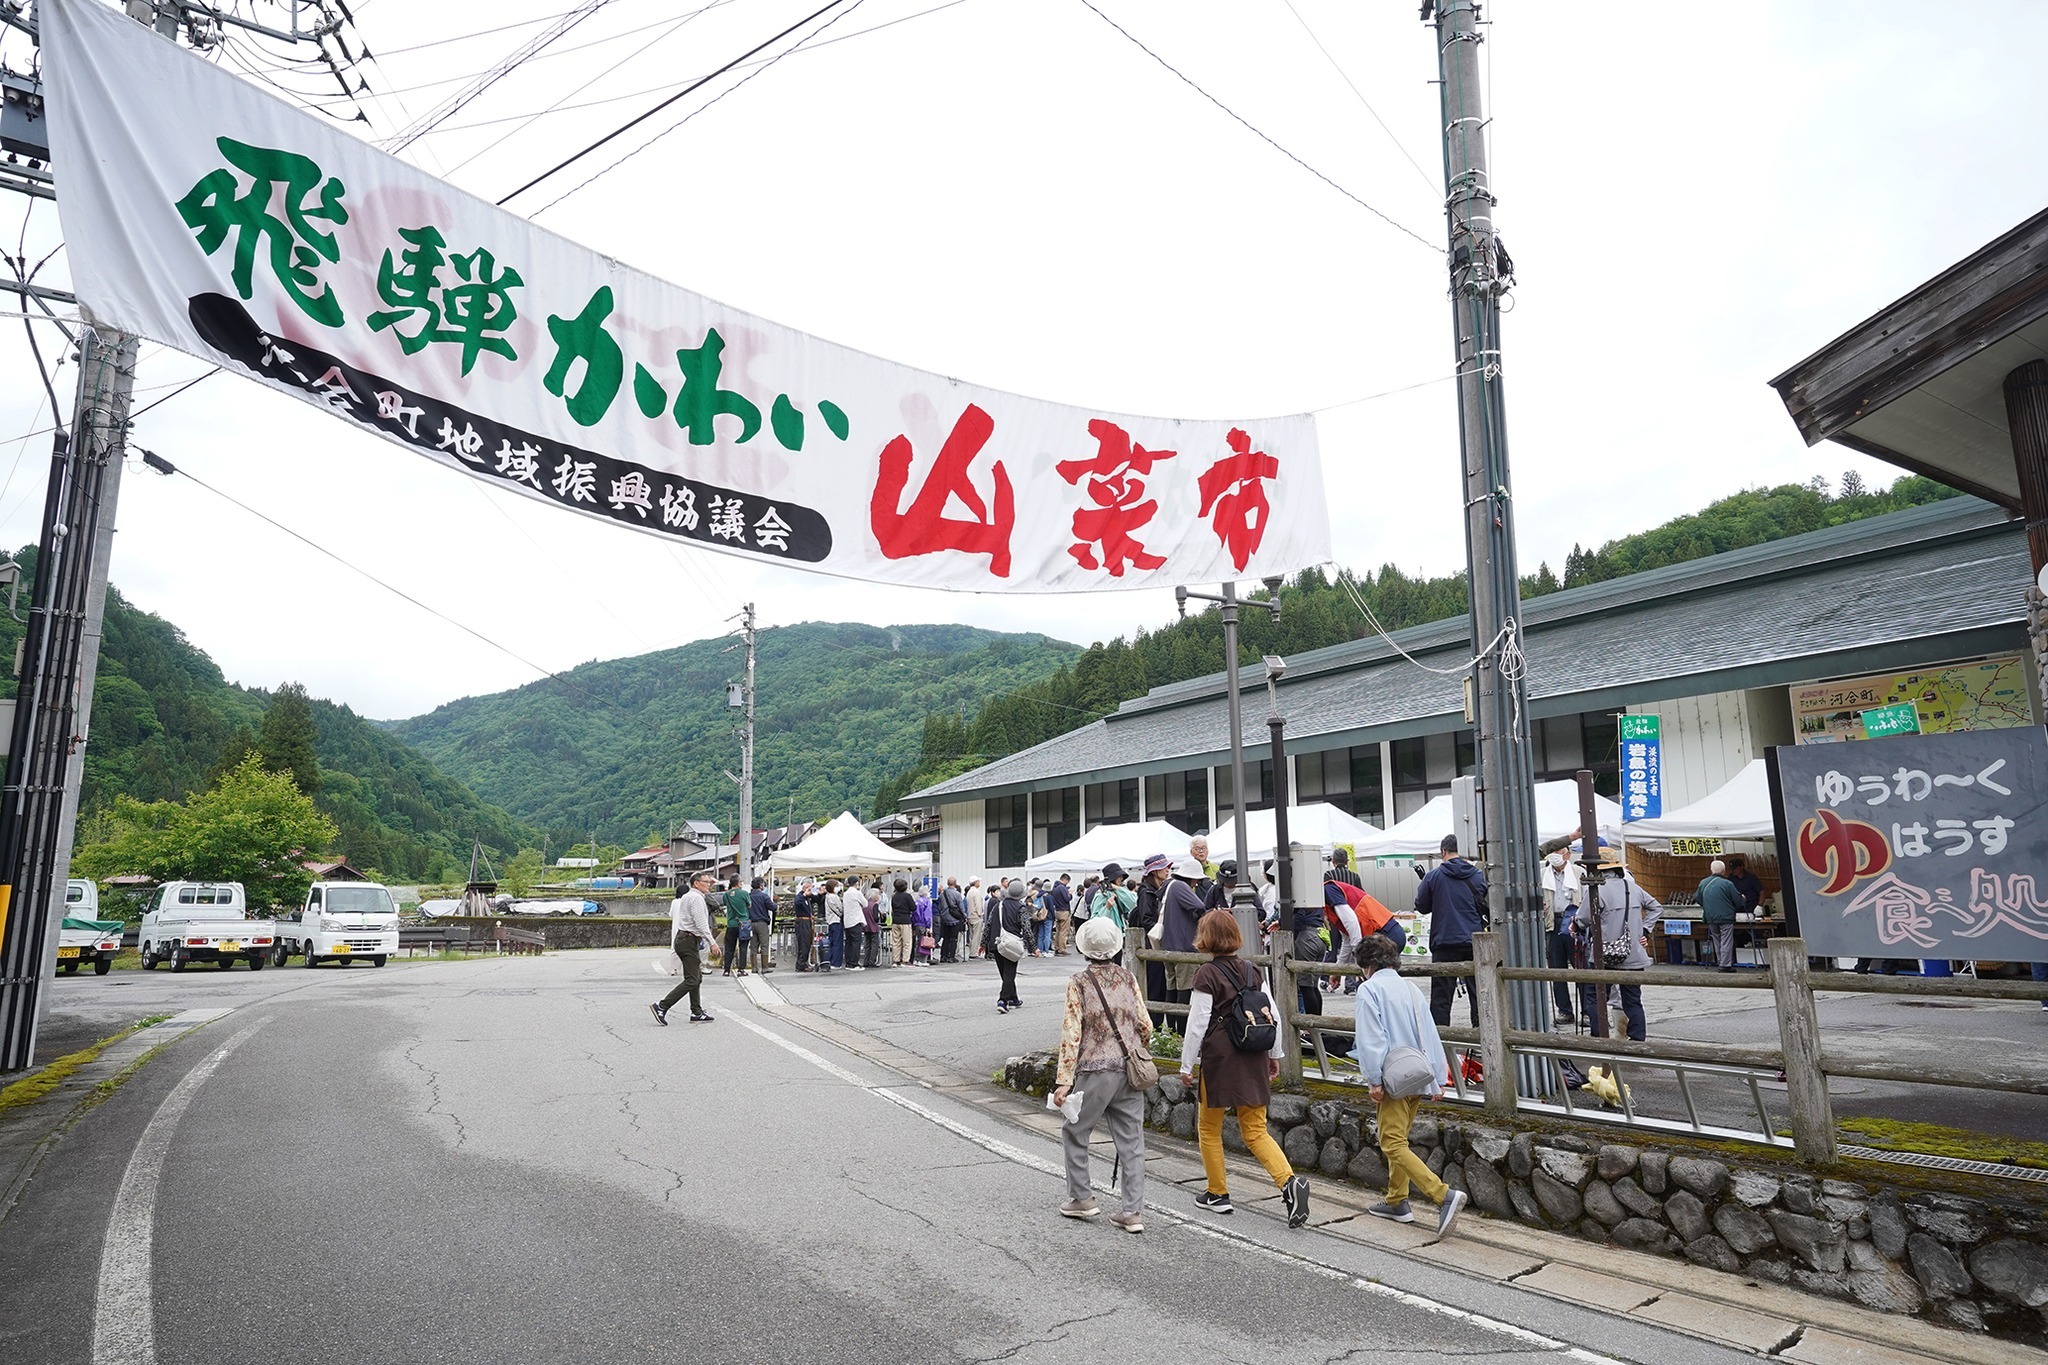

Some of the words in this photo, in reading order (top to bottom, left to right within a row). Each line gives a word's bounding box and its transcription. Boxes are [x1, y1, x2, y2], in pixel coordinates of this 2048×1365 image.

[1628, 743, 1648, 817] 岩魚の塩焼き
[1671, 838, 1721, 855] 岩魚の塩焼き
